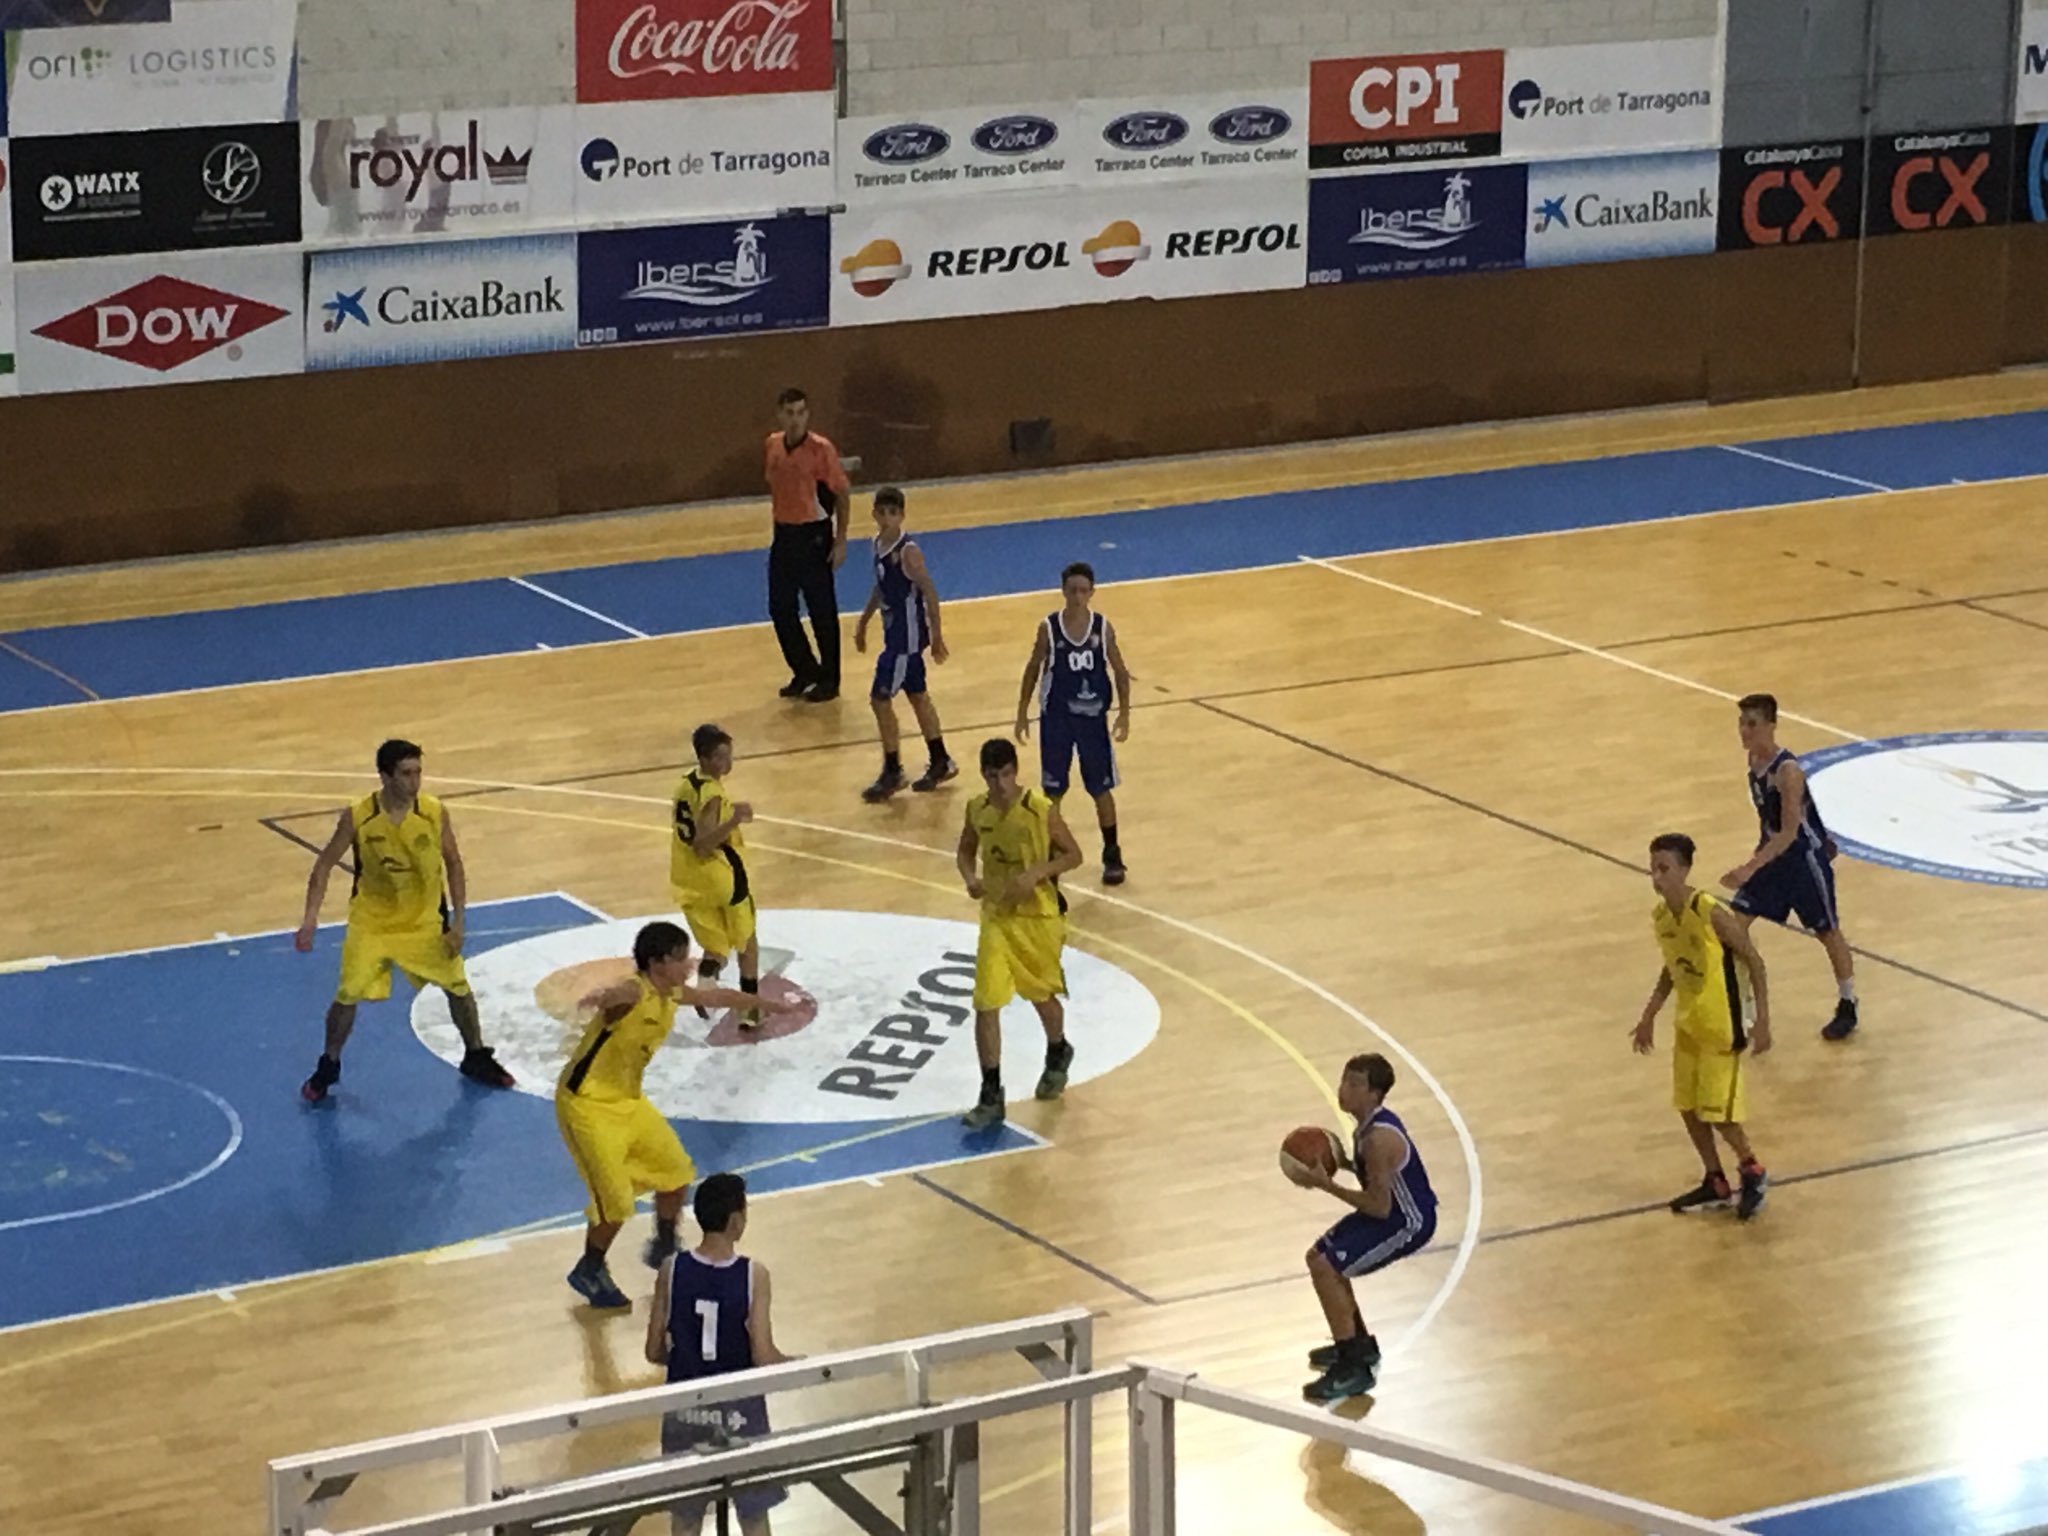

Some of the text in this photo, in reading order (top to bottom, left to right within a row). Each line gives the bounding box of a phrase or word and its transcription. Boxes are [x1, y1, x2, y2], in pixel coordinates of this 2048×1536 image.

[129, 46, 277, 75] LOGISTICS
[1348, 62, 1461, 130] CPI
[1543, 90, 1711, 117] Port de Tarragona
[989, 122, 1041, 148] Ford
[1121, 117, 1172, 144] Ford
[1225, 112, 1276, 137] Ford
[881, 131, 932, 157] Ford
[1200, 147, 1299, 166] Tarraco Center
[1394, 140, 1468, 158] INDUSTRIAL
[349, 119, 478, 202] royal
[623, 147, 830, 177] Port de Tarragona
[963, 158, 1065, 181] Tarraco Center
[1094, 154, 1195, 173] Tarraco Center
[74, 171, 141, 194] WATX
[854, 166, 958, 188] Tarraco Center
[1890, 152, 1991, 230] CX
[1574, 187, 1714, 229] CaixaBank
[1742, 166, 1842, 245] CX
[1164, 223, 1302, 260] REPSOL
[927, 241, 1071, 279] REPSOL
[377, 275, 565, 325] CaixaBank
[95, 304, 239, 348] DOW
[1068, 650, 1095, 671] 00
[695, 1299, 720, 1361] 1
